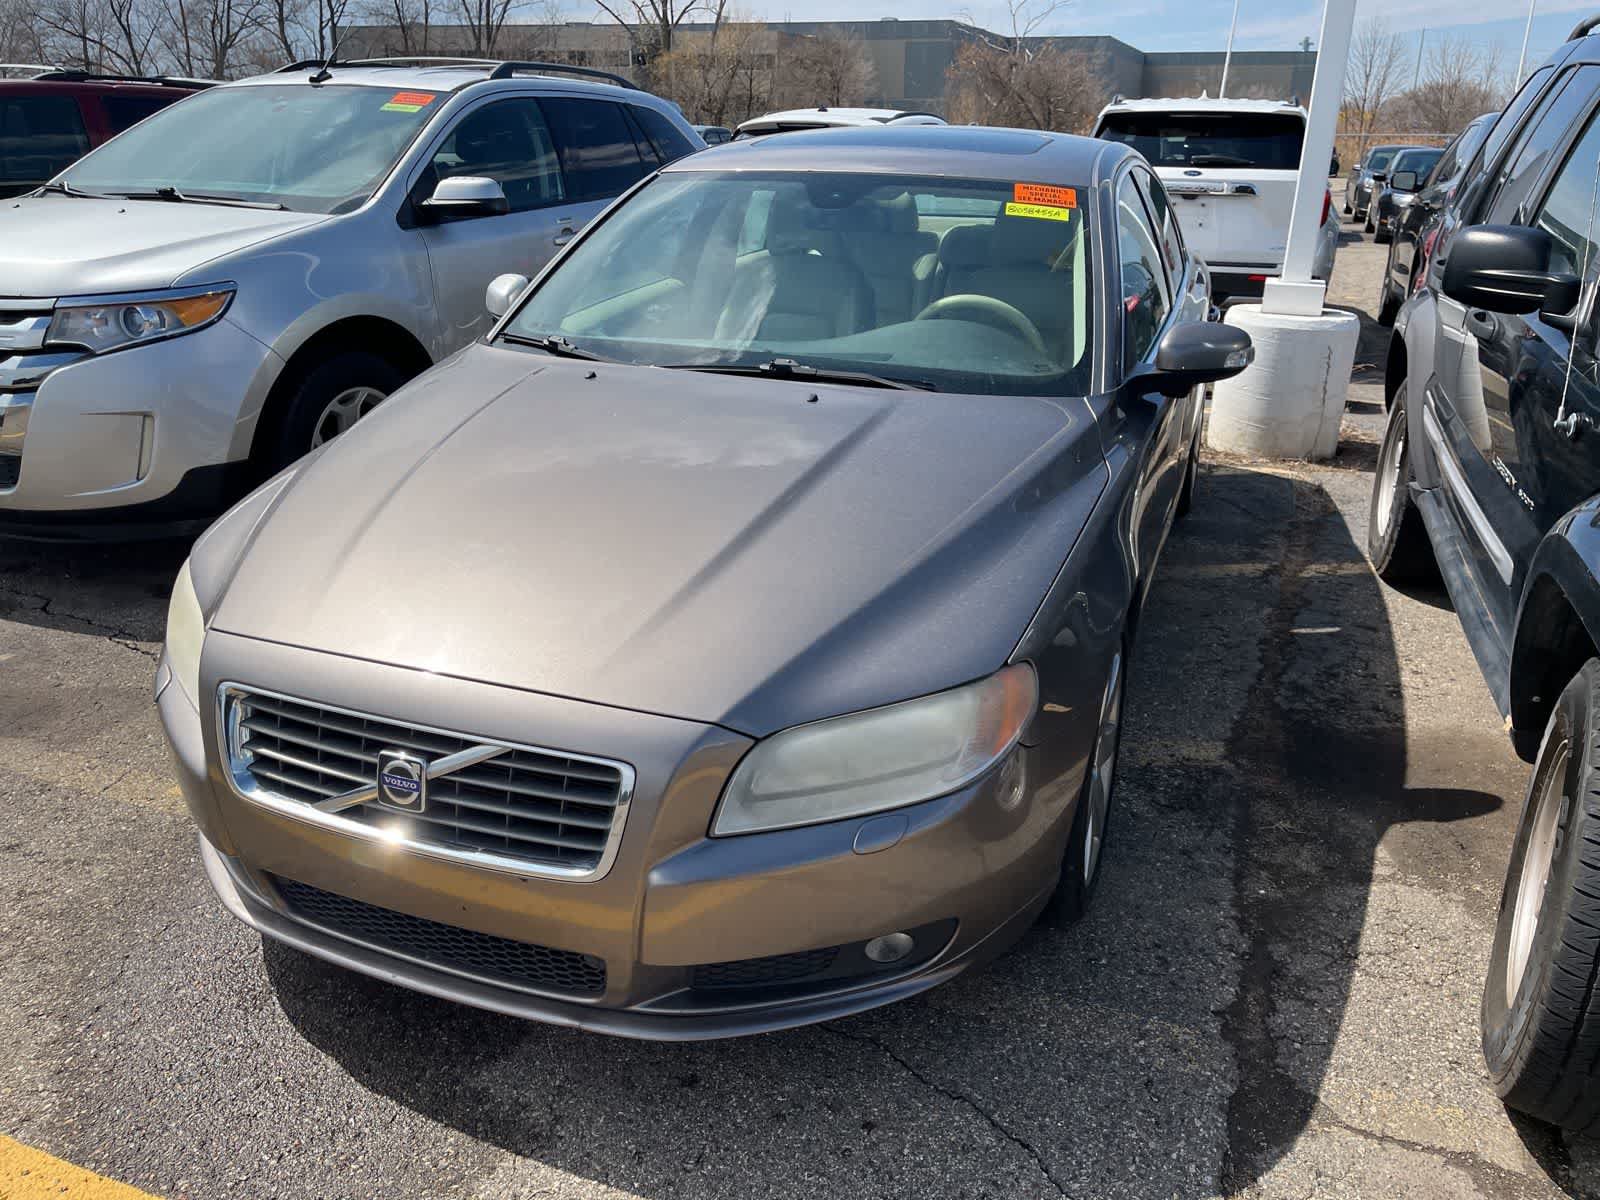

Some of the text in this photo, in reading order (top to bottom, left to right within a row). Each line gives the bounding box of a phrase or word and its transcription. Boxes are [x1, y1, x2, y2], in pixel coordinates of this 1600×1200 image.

[1029, 191, 1062, 199] SPECIAL
[1033, 197, 1074, 206] MANAGER
[384, 776, 417, 789] VOLVO
